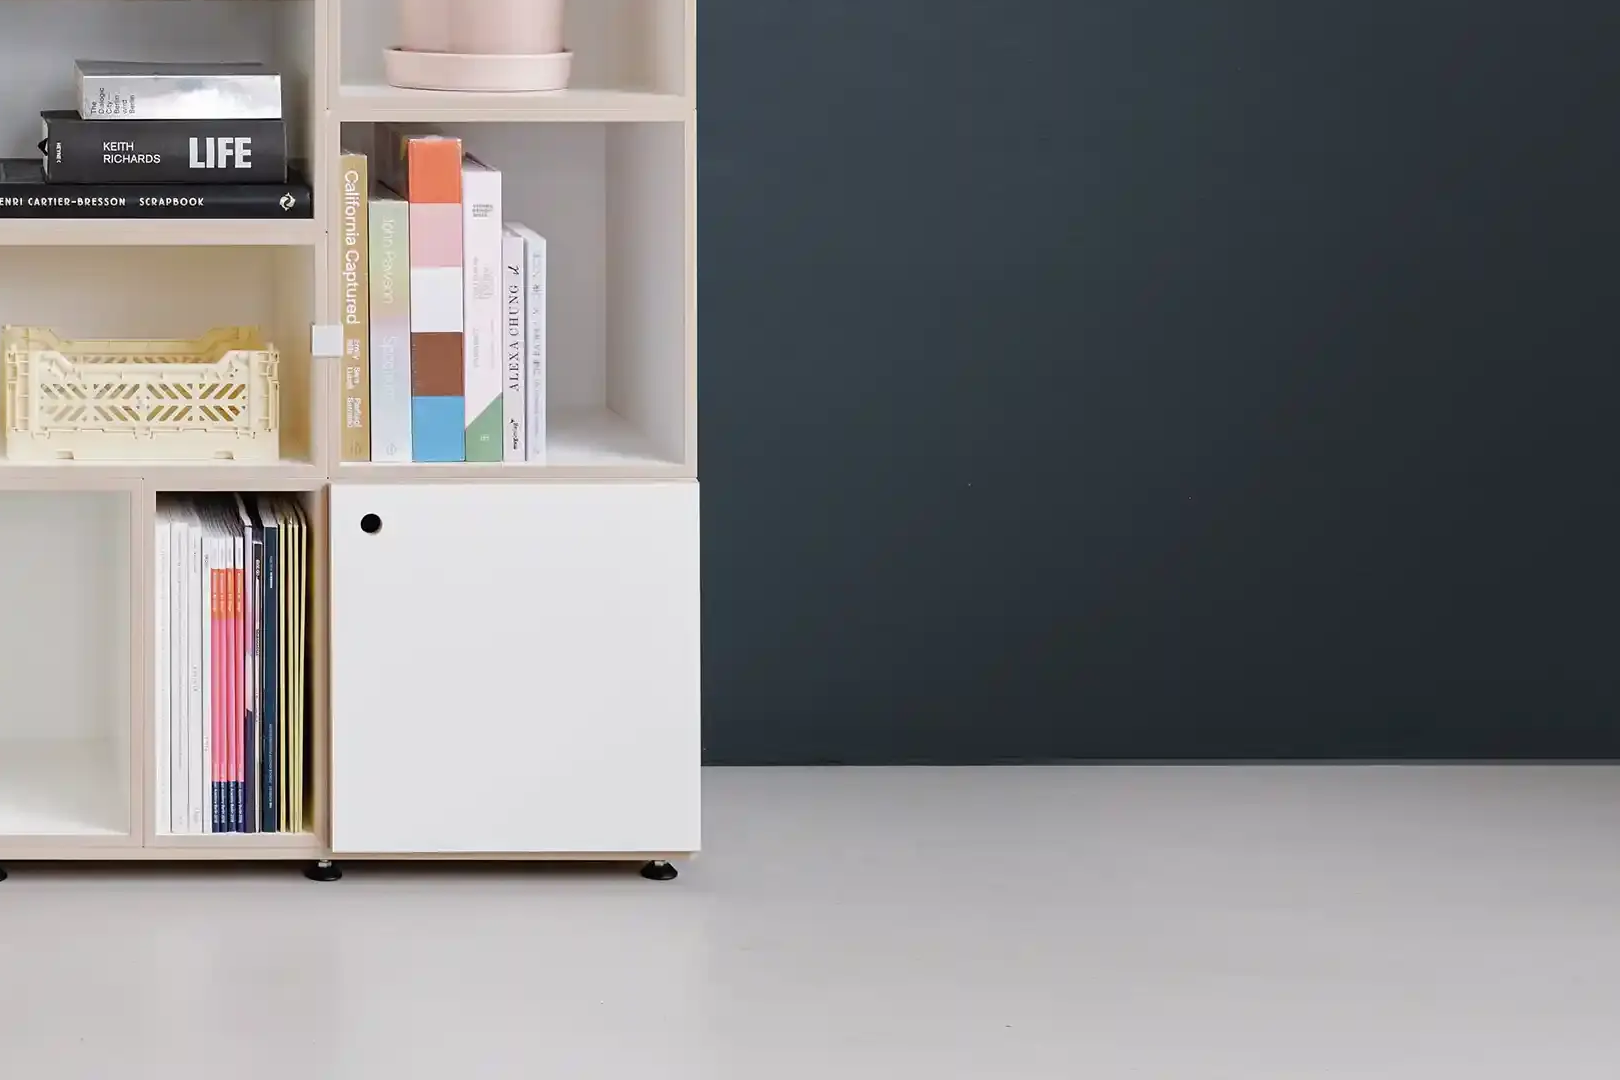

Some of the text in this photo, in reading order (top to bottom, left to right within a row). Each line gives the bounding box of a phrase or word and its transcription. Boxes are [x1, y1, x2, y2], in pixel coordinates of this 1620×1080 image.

[103, 142, 134, 152] KEITH
[103, 154, 161, 164] RICHARDS
[189, 137, 252, 168] LIFE
[27, 197, 127, 207] CARTIER-BRESSON
[139, 197, 205, 207] SCRAPBOOK
[343, 170, 360, 324] California Captured
[382, 218, 396, 304] John Pawson
[509, 284, 519, 392] ALEXA CHUNG
